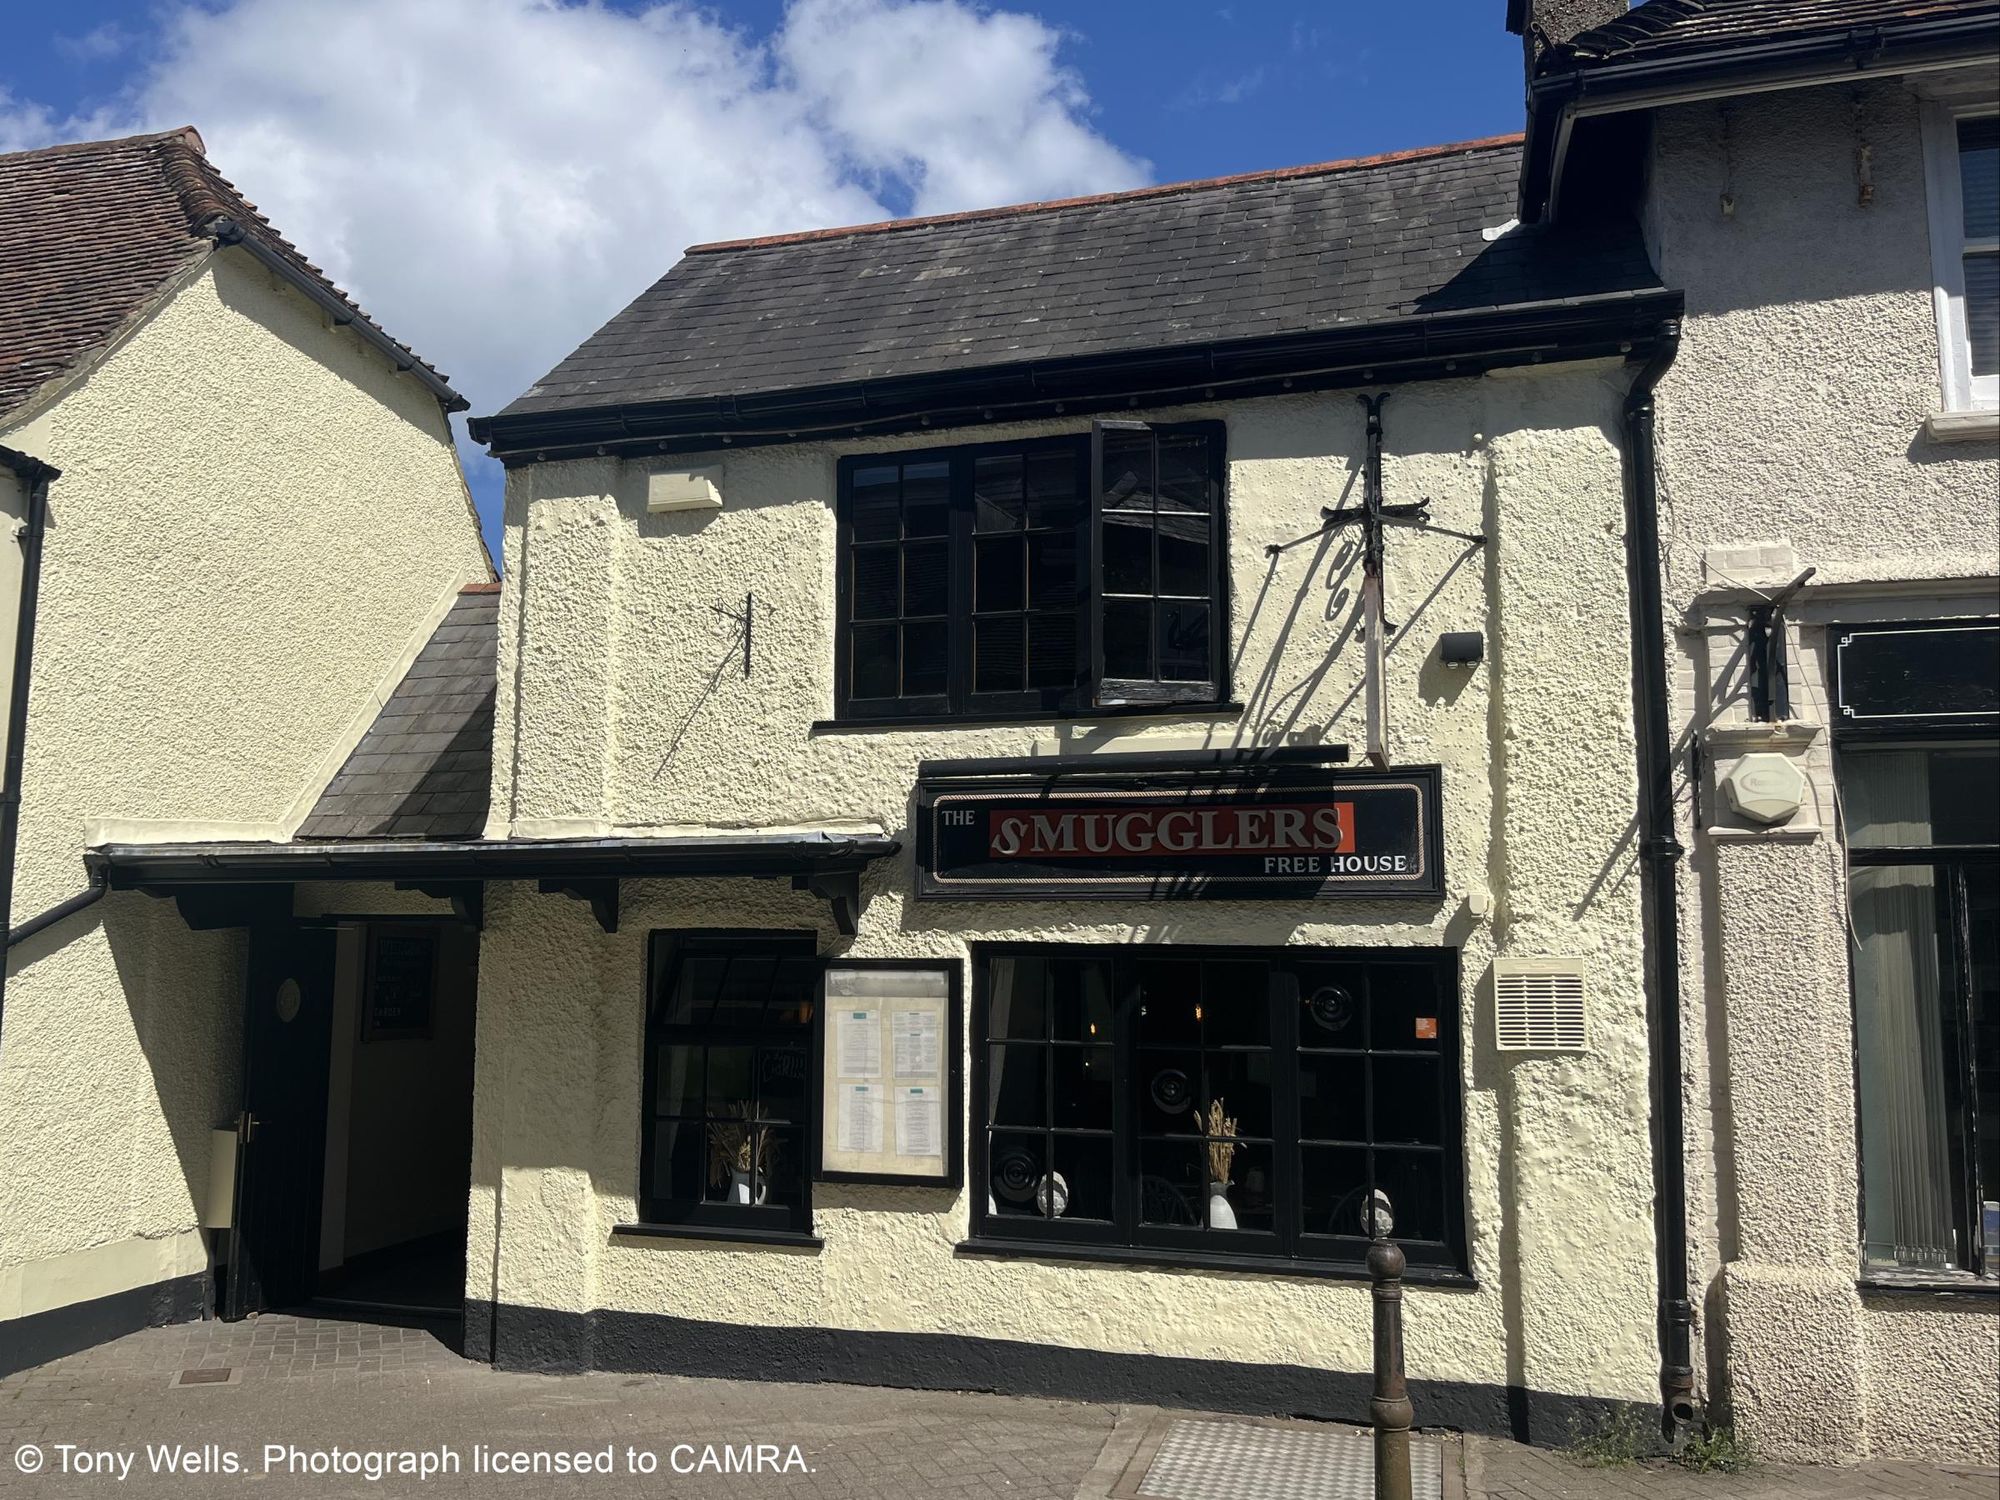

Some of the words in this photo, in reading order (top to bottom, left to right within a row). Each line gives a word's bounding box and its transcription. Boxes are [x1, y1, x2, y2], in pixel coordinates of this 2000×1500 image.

[942, 810, 976, 826] THE
[991, 808, 1344, 854] SMUGGLERS
[1264, 856, 1321, 874] FREE
[1330, 855, 1408, 873] HOUSE
